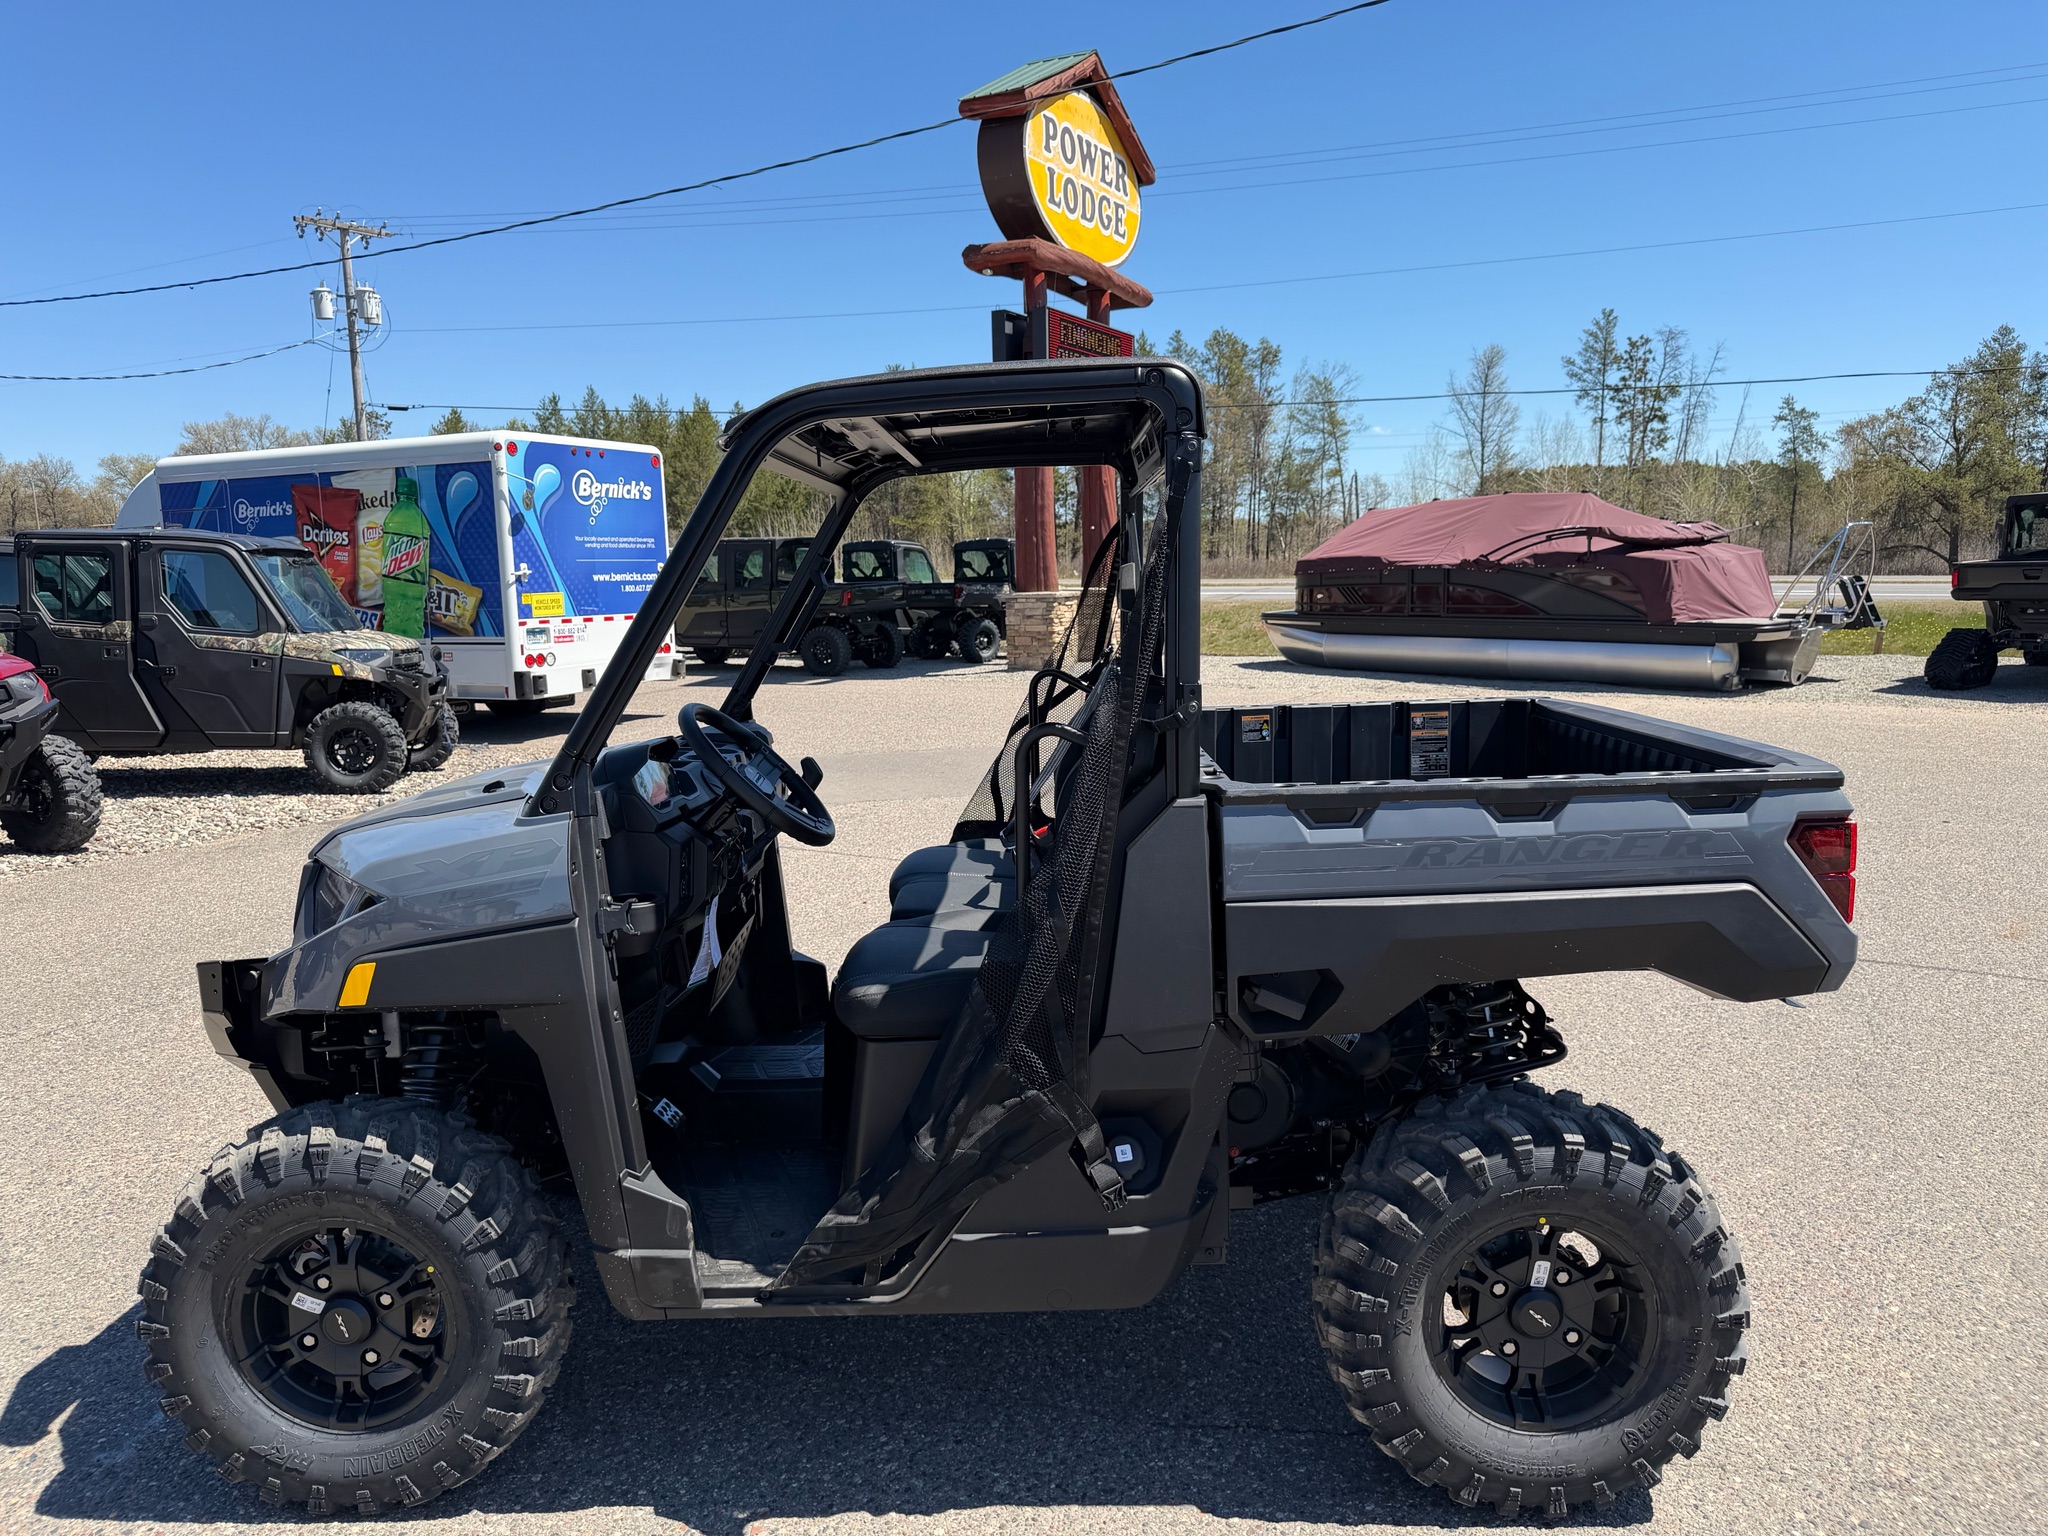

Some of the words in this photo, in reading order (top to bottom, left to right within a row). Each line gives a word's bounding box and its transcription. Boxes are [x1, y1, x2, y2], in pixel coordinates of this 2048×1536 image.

[1043, 113, 1129, 198] POWER
[1046, 166, 1127, 239] LODGE
[1060, 321, 1121, 356] FINANCING
[578, 476, 652, 501] Bernick's
[238, 501, 293, 518] Bernick's
[303, 525, 349, 545] Doritos
[364, 525, 384, 543] Lay's
[403, 838, 557, 890] XP
[1402, 831, 1713, 868] RANGER
[1396, 1212, 1473, 1336] X-TERRAIN
[343, 1400, 465, 1479] X-TERRAIN
